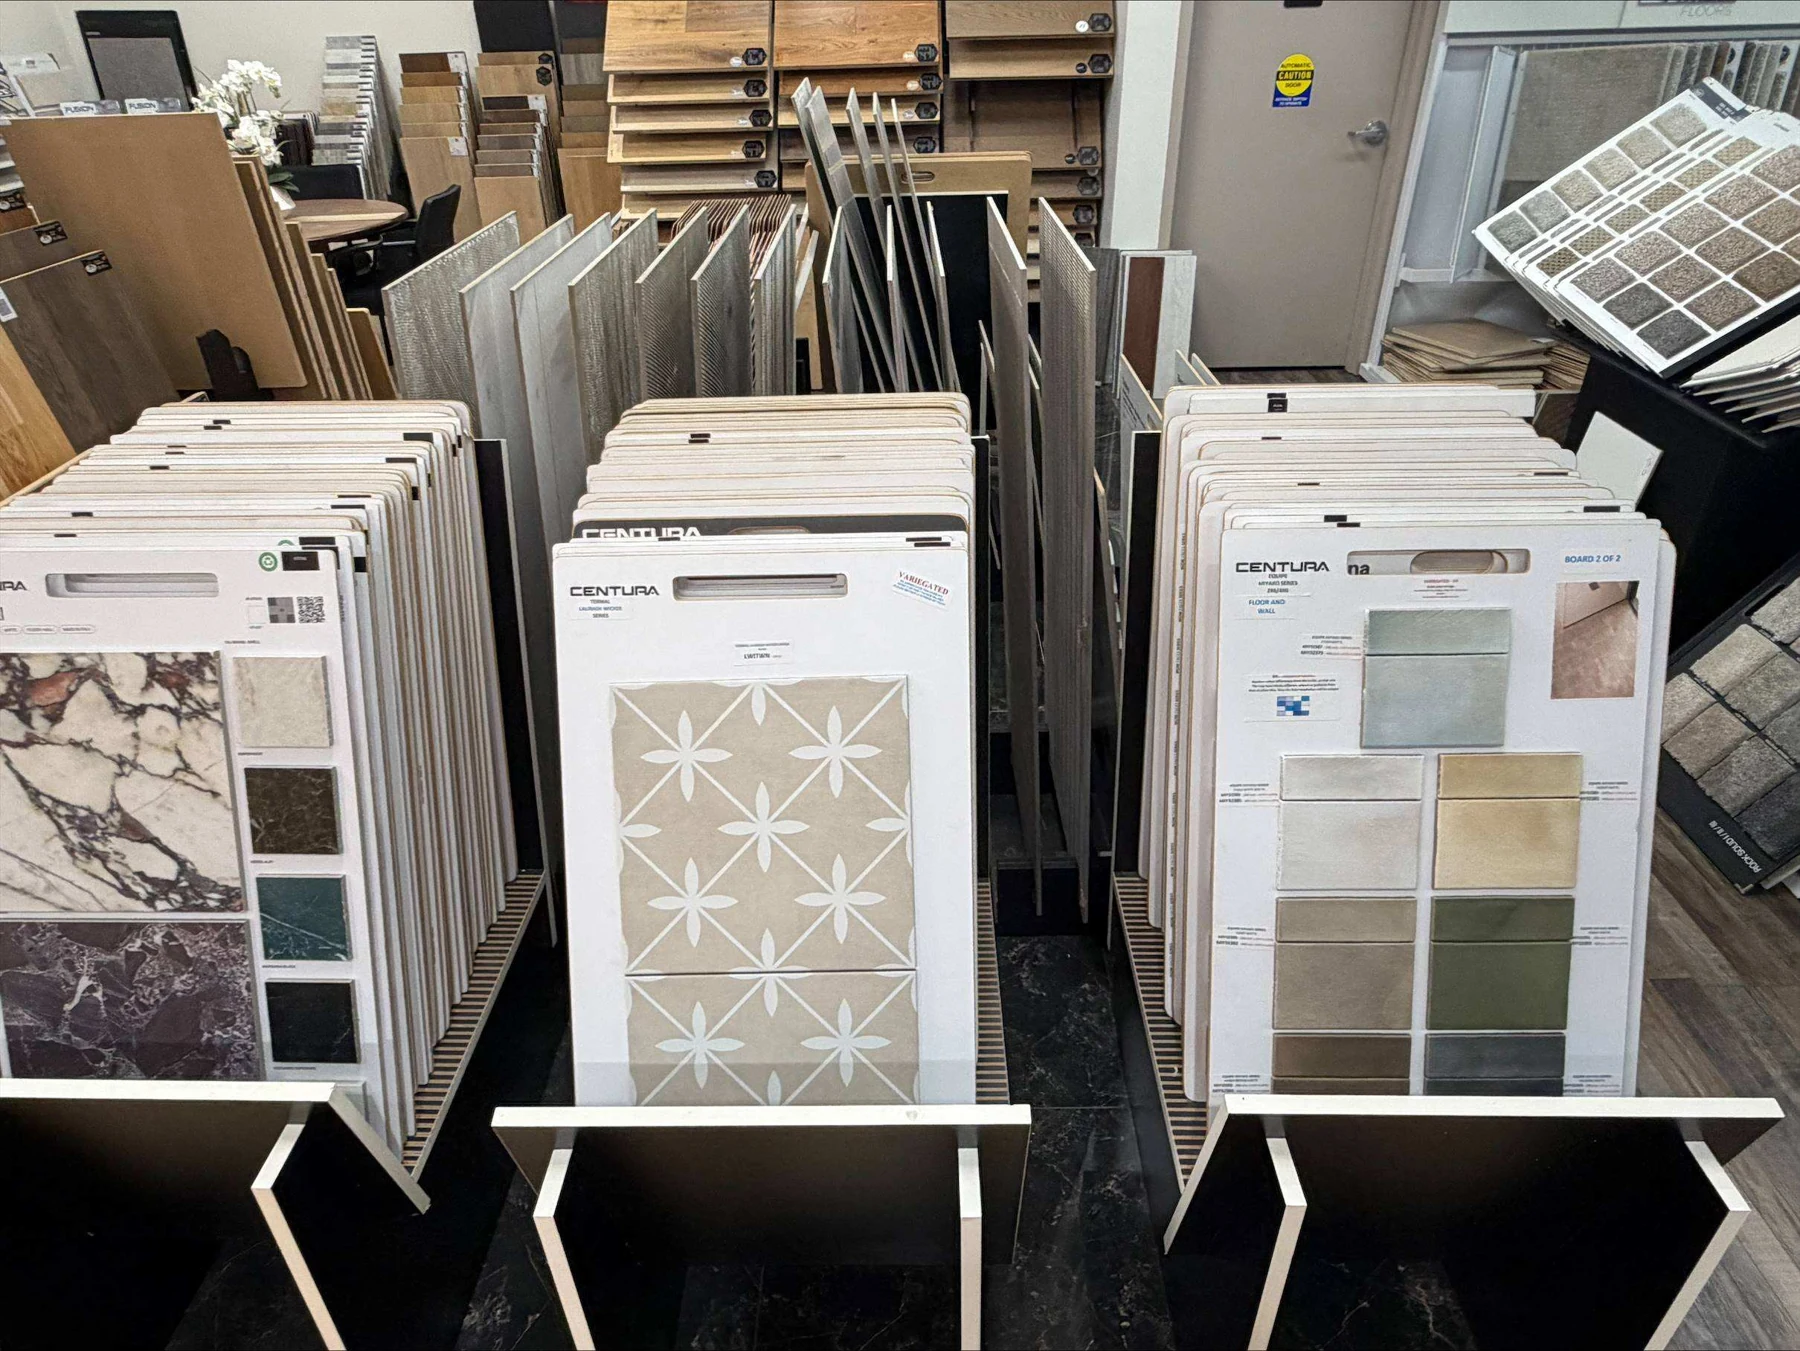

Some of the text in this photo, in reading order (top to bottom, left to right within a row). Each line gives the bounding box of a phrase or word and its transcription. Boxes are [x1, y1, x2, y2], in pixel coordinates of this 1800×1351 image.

[1278, 71, 1312, 80] CAUTION
[582, 527, 701, 538] CENTURA
[1564, 554, 1622, 563] BOARD 2 OF 2
[1235, 561, 1331, 573] CENTURA
[899, 571, 949, 595] VARIEGATED
[570, 585, 660, 597] CENTURA
[1725, 837, 1746, 857] SOLID
[1741, 853, 1762, 873] ROCK
